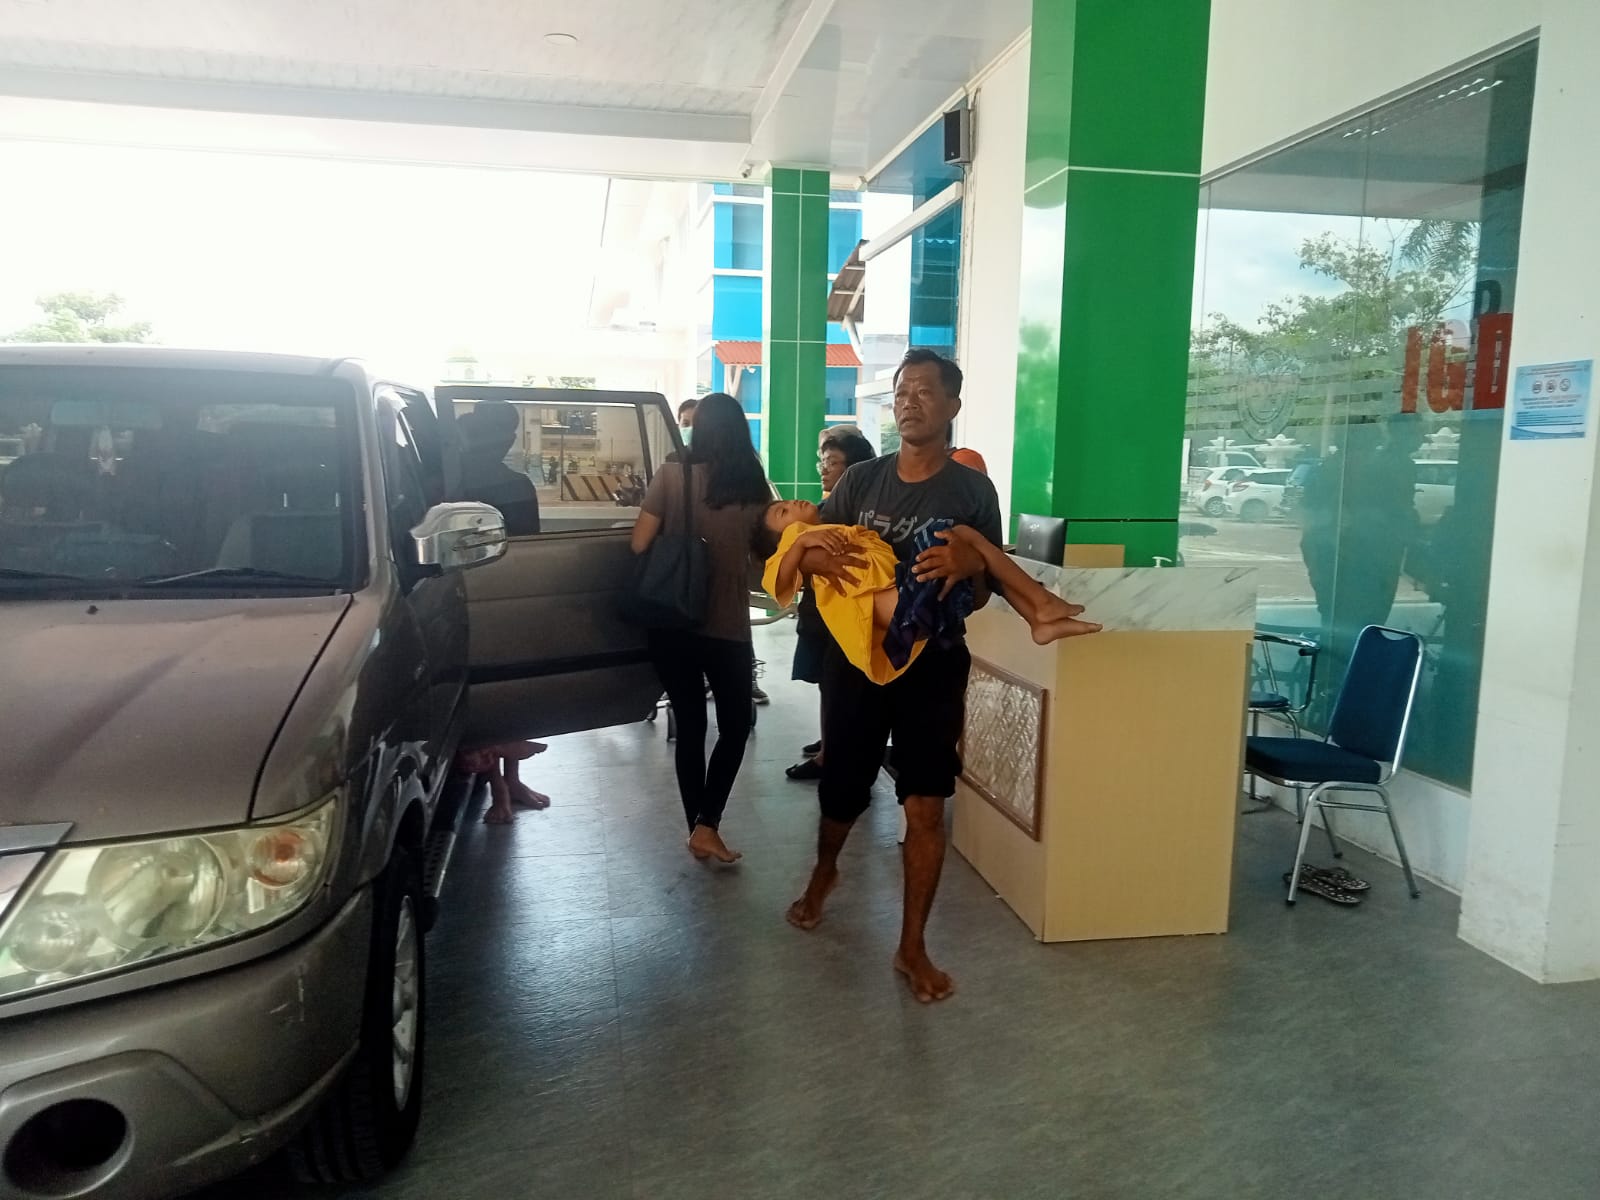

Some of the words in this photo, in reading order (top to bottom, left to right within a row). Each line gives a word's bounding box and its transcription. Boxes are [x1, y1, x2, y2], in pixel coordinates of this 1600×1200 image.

[1401, 313, 1513, 413] IGD
[858, 510, 953, 545] パラダイ
